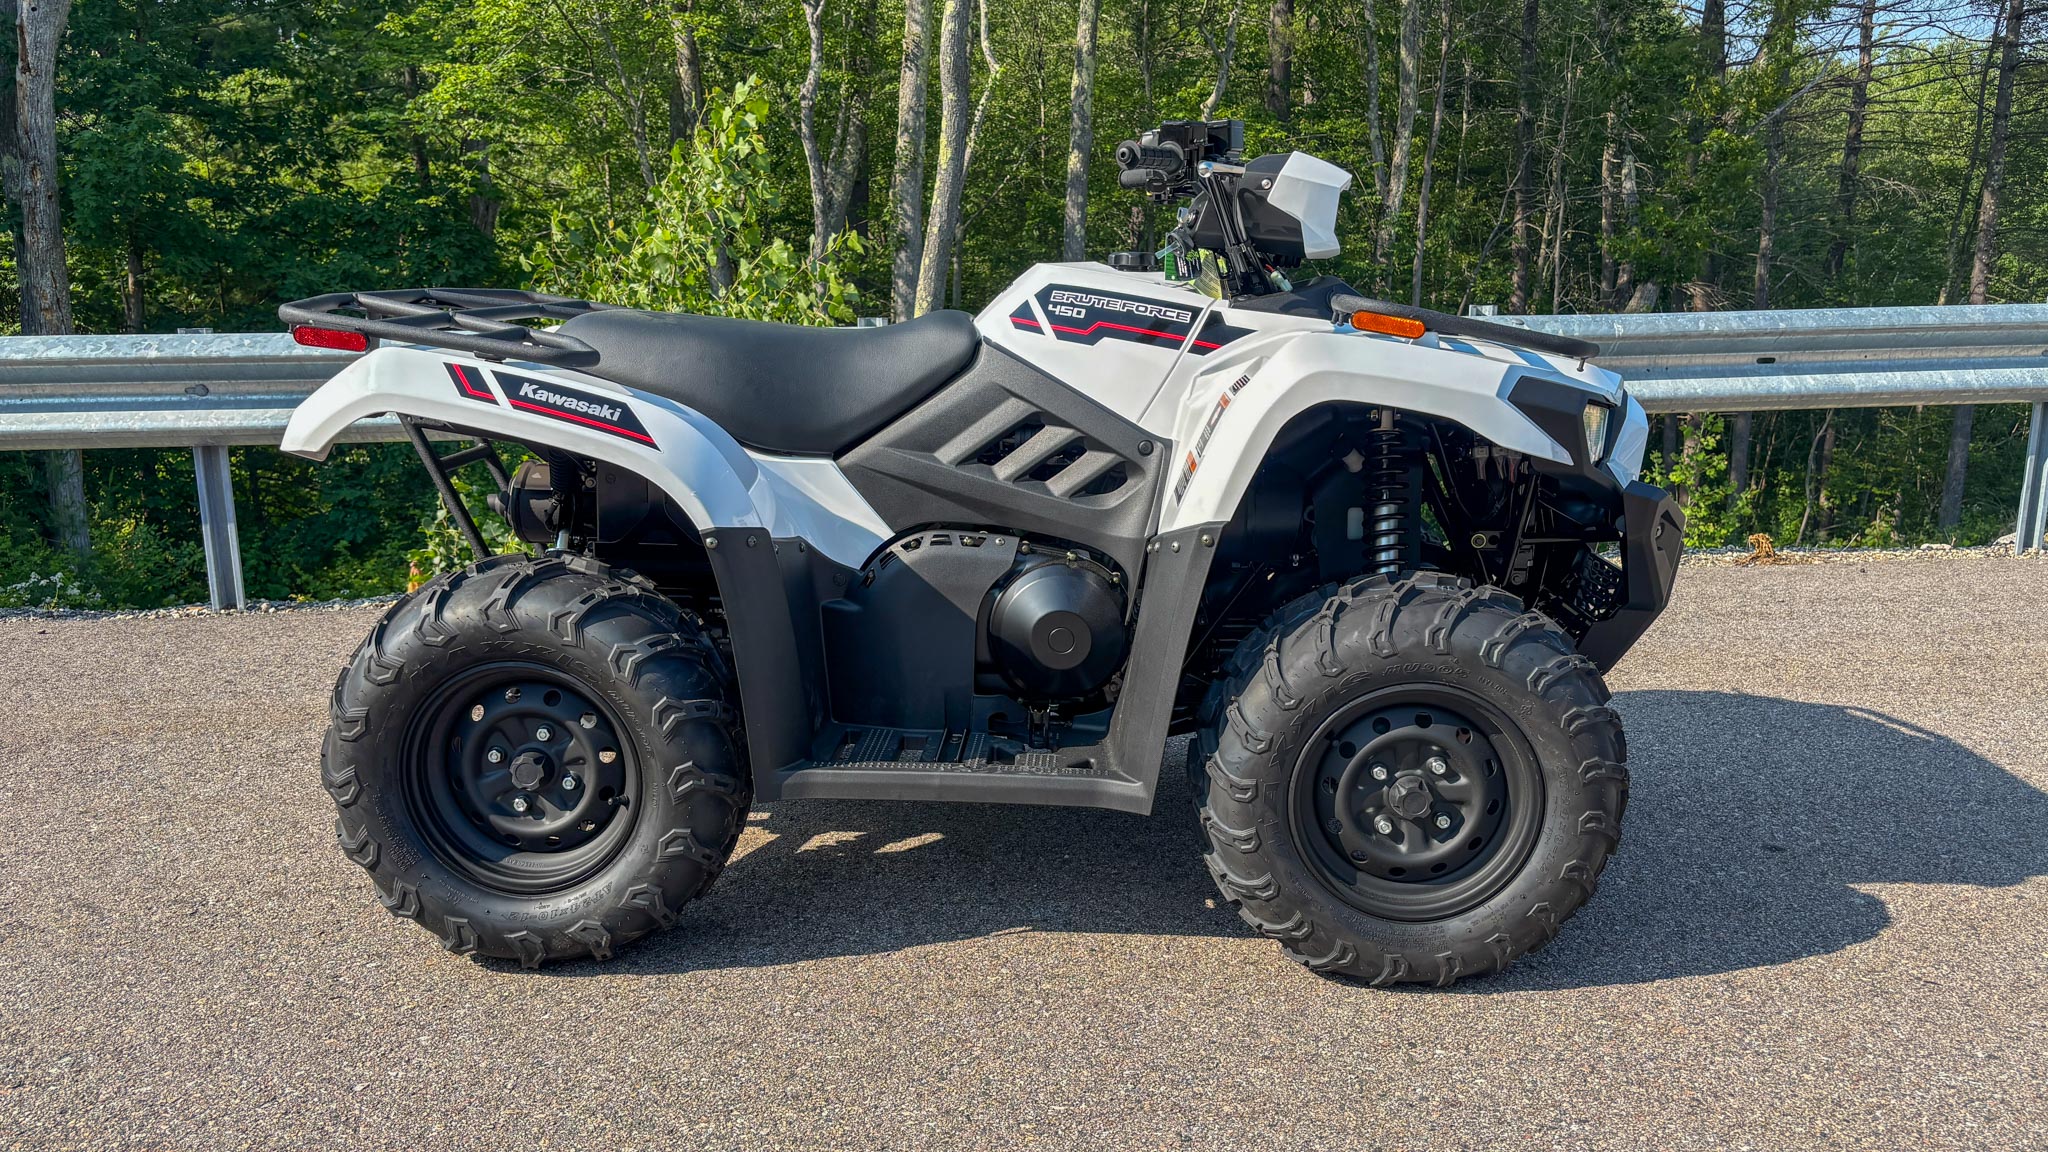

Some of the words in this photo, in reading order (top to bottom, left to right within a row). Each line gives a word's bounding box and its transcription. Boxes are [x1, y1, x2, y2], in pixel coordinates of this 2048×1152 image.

[1047, 303, 1086, 319] 450
[1050, 290, 1120, 310] BRUTE
[1120, 302, 1193, 324] FORCE
[518, 382, 622, 422] Kawasaki
